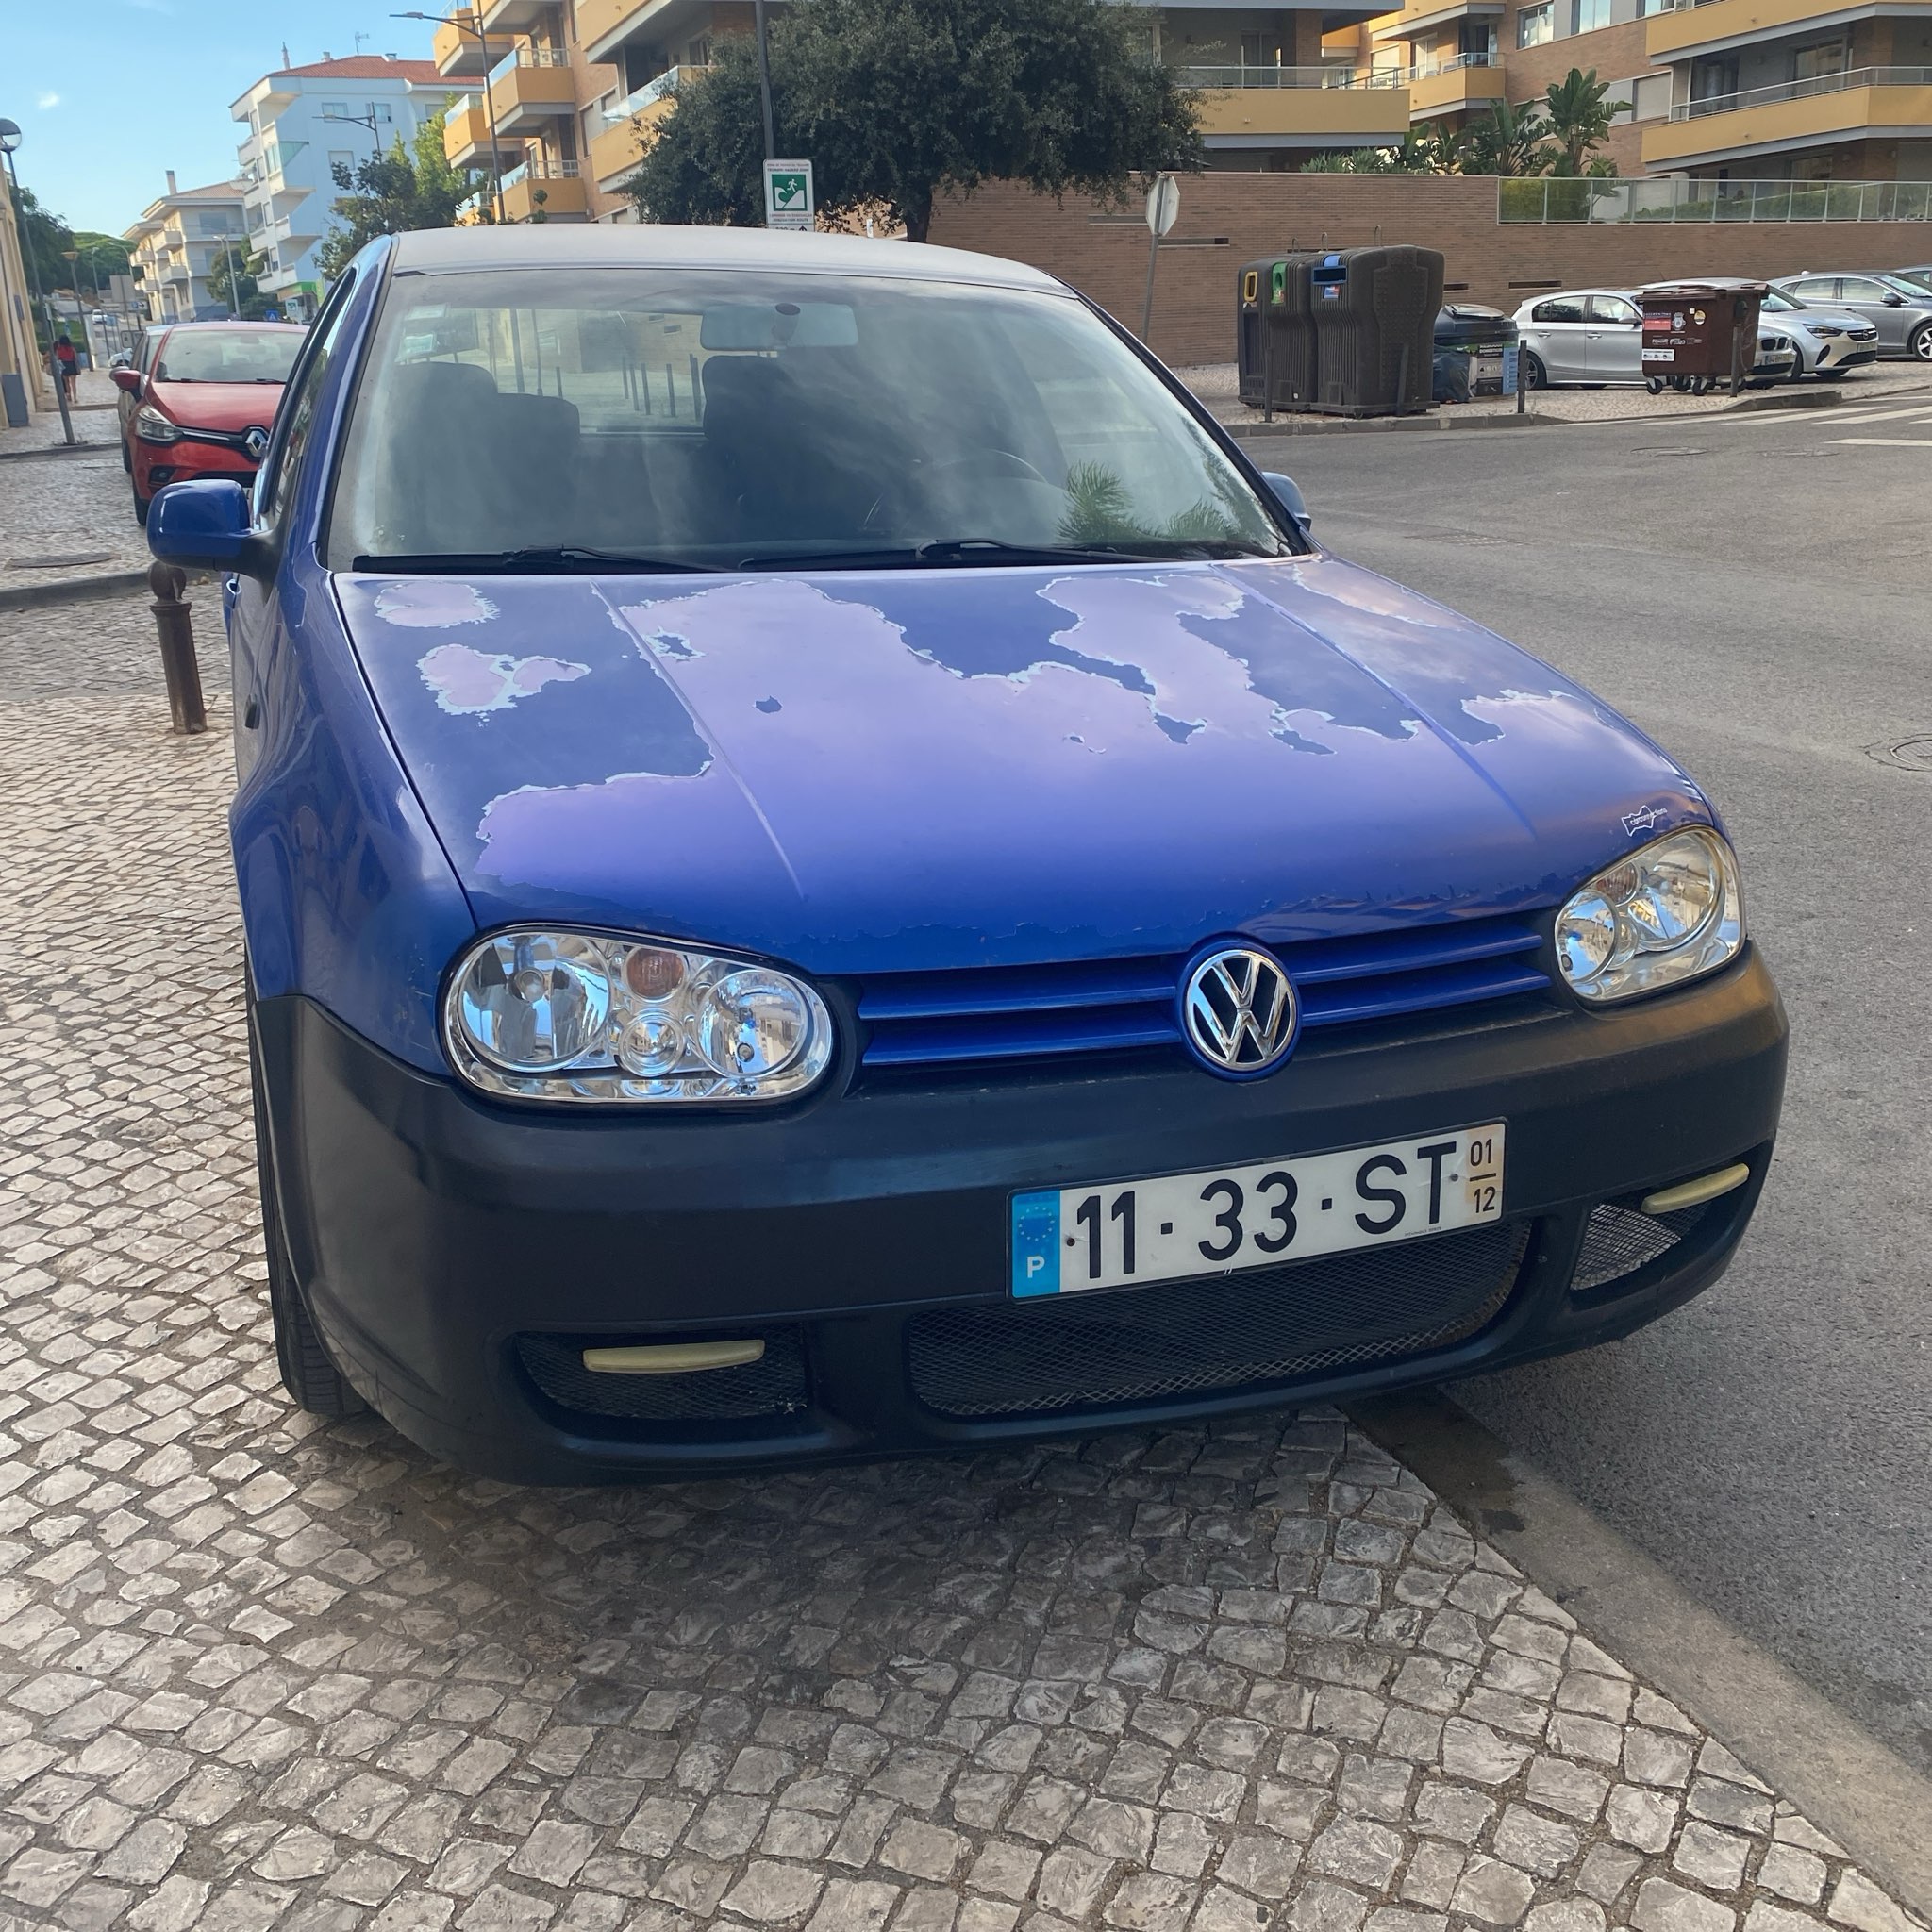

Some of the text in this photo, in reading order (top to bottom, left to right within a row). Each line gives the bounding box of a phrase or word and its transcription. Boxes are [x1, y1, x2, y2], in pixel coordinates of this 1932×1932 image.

[1469, 1138, 1493, 1168] 01
[1473, 1186, 1496, 1214] 12
[1026, 1255, 1045, 1278] P
